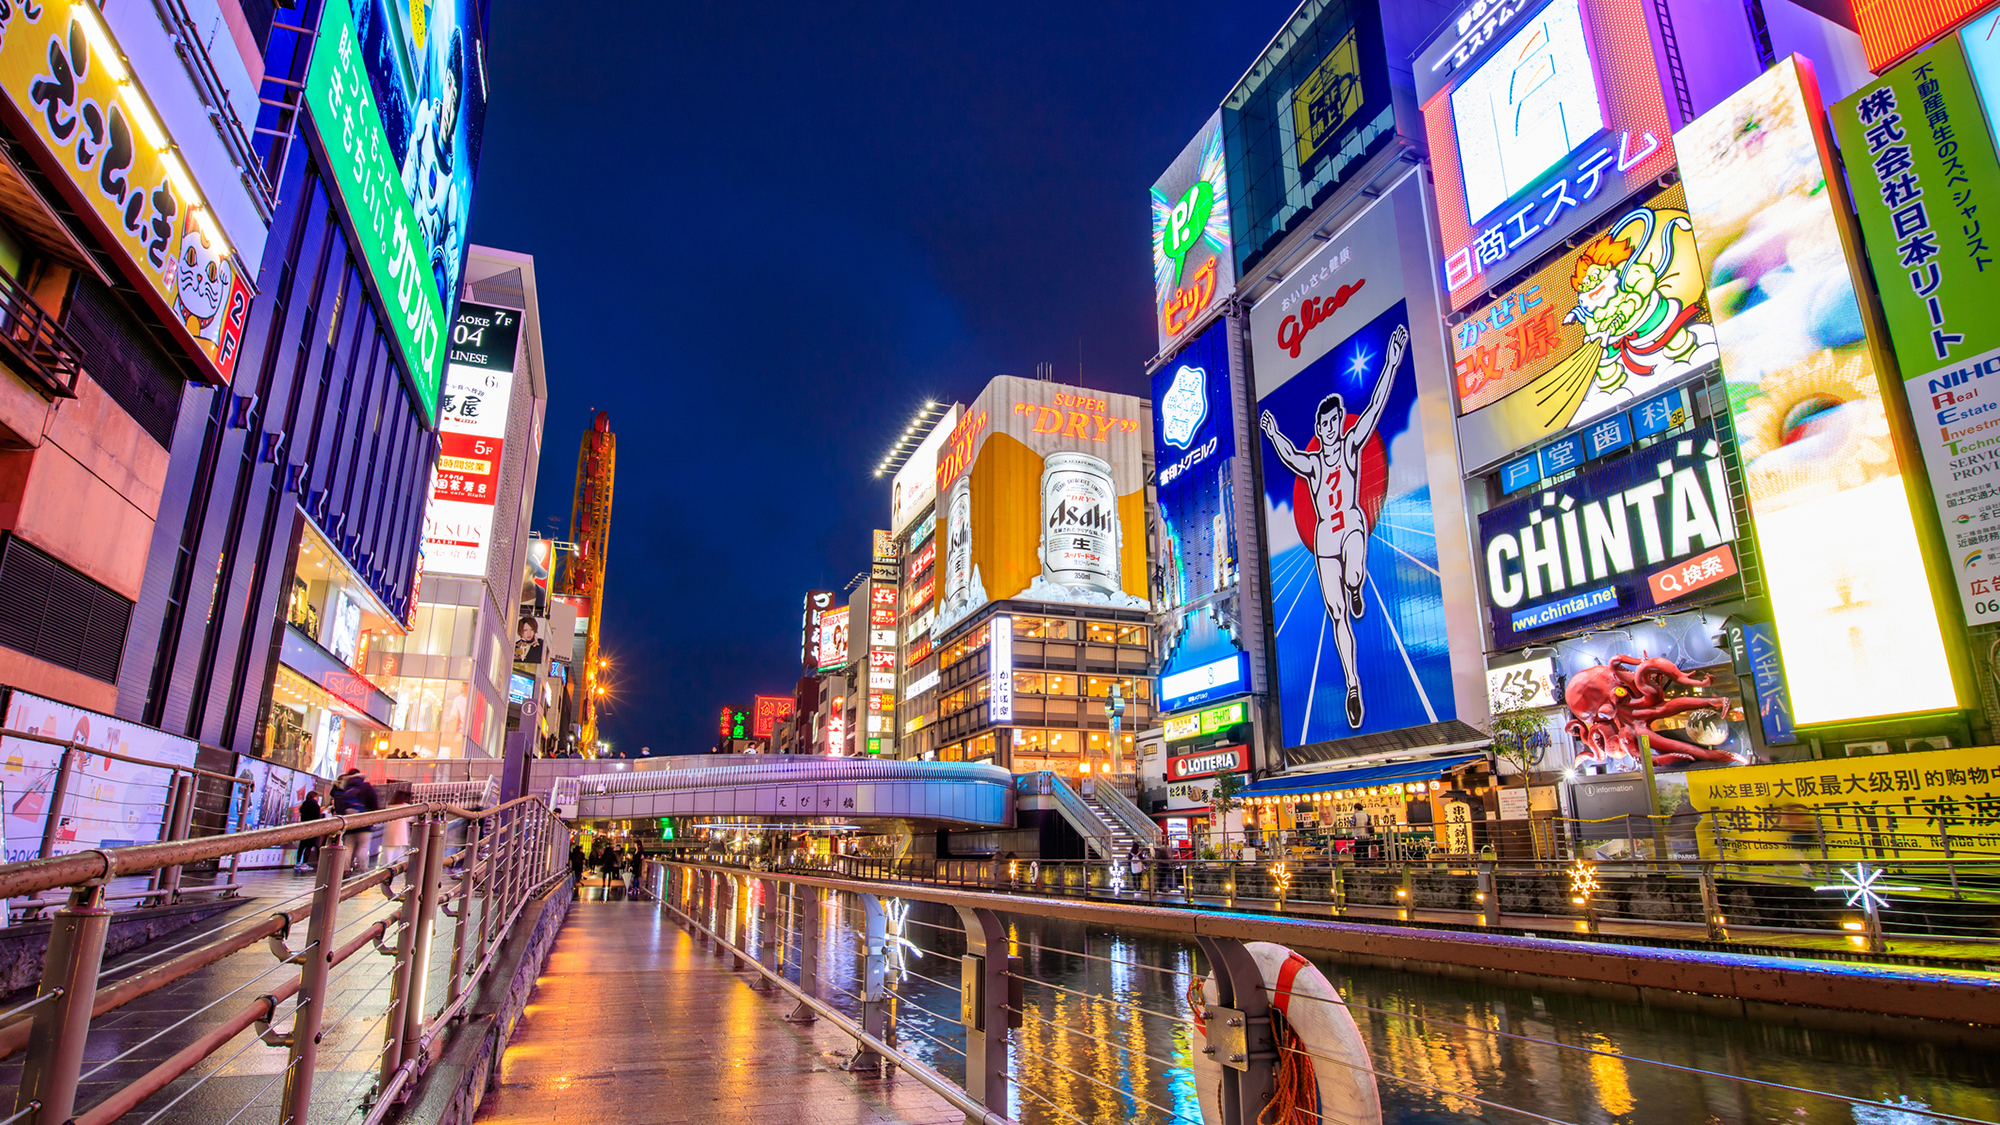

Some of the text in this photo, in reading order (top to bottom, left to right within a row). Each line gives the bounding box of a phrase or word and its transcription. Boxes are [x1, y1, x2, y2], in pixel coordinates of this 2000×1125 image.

[327, 65, 387, 256] きもちいい。
[1911, 61, 1992, 273] 不動産再生のスペシャリスト
[1444, 131, 1660, 292] 日商エステム
[1857, 85, 1964, 360] 株式会社日本リート
[1164, 256, 1217, 336] ピップ
[1281, 246, 1353, 312] おいしさと健康
[387, 204, 439, 391] サロンパス
[219, 290, 245, 366] 2F
[494, 311, 513, 327] 7F
[1458, 285, 1543, 350] かぜに
[1453, 303, 1560, 399] 改源
[1054, 392, 1106, 412] SUPER
[1932, 388, 1979, 410] Real
[1937, 402, 1998, 426] Estate
[950, 410, 974, 447] SUPER
[1671, 410, 1683, 424] 3F
[474, 440, 494, 455] 5F
[1508, 397, 1671, 487] 戸堂歯科
[1160, 436, 1218, 487] 雪印メグミルク
[1325, 465, 1345, 534] グリコ
[1946, 486, 2000, 508] 国土交通大
[1049, 499, 1112, 533] Asahi
[1486, 440, 1740, 608] CHINTAI
[1064, 552, 1101, 562] スーパードライ
[1072, 538, 1091, 551] 生
[1074, 572, 1091, 580] 350ml
[1682, 555, 1724, 587] 検索
[1975, 599, 2000, 614] 06
[1731, 627, 1744, 661] 2F
[1187, 753, 1235, 773] LOTTERIA
[779, 796, 854, 809] えびす橋
